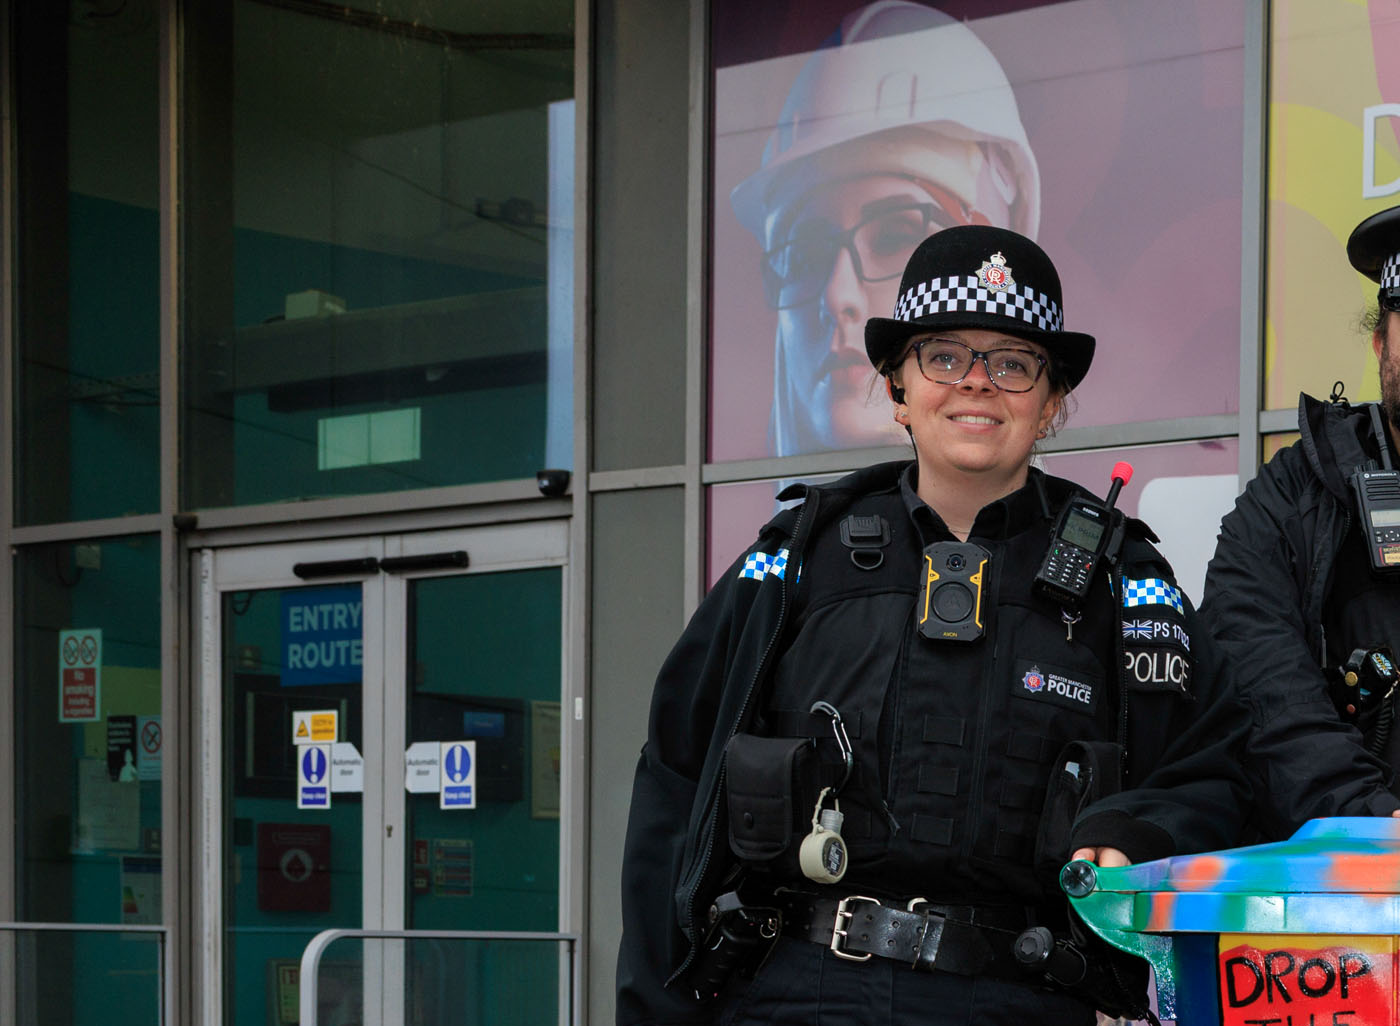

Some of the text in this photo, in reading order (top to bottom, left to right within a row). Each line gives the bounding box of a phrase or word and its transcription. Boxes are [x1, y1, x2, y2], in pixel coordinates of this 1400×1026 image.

[289, 602, 362, 632] ENTRY
[1153, 621, 1170, 638] PS
[288, 639, 363, 669] ROUTE
[1047, 679, 1092, 704] POLICE
[1226, 951, 1371, 1009] DROP
